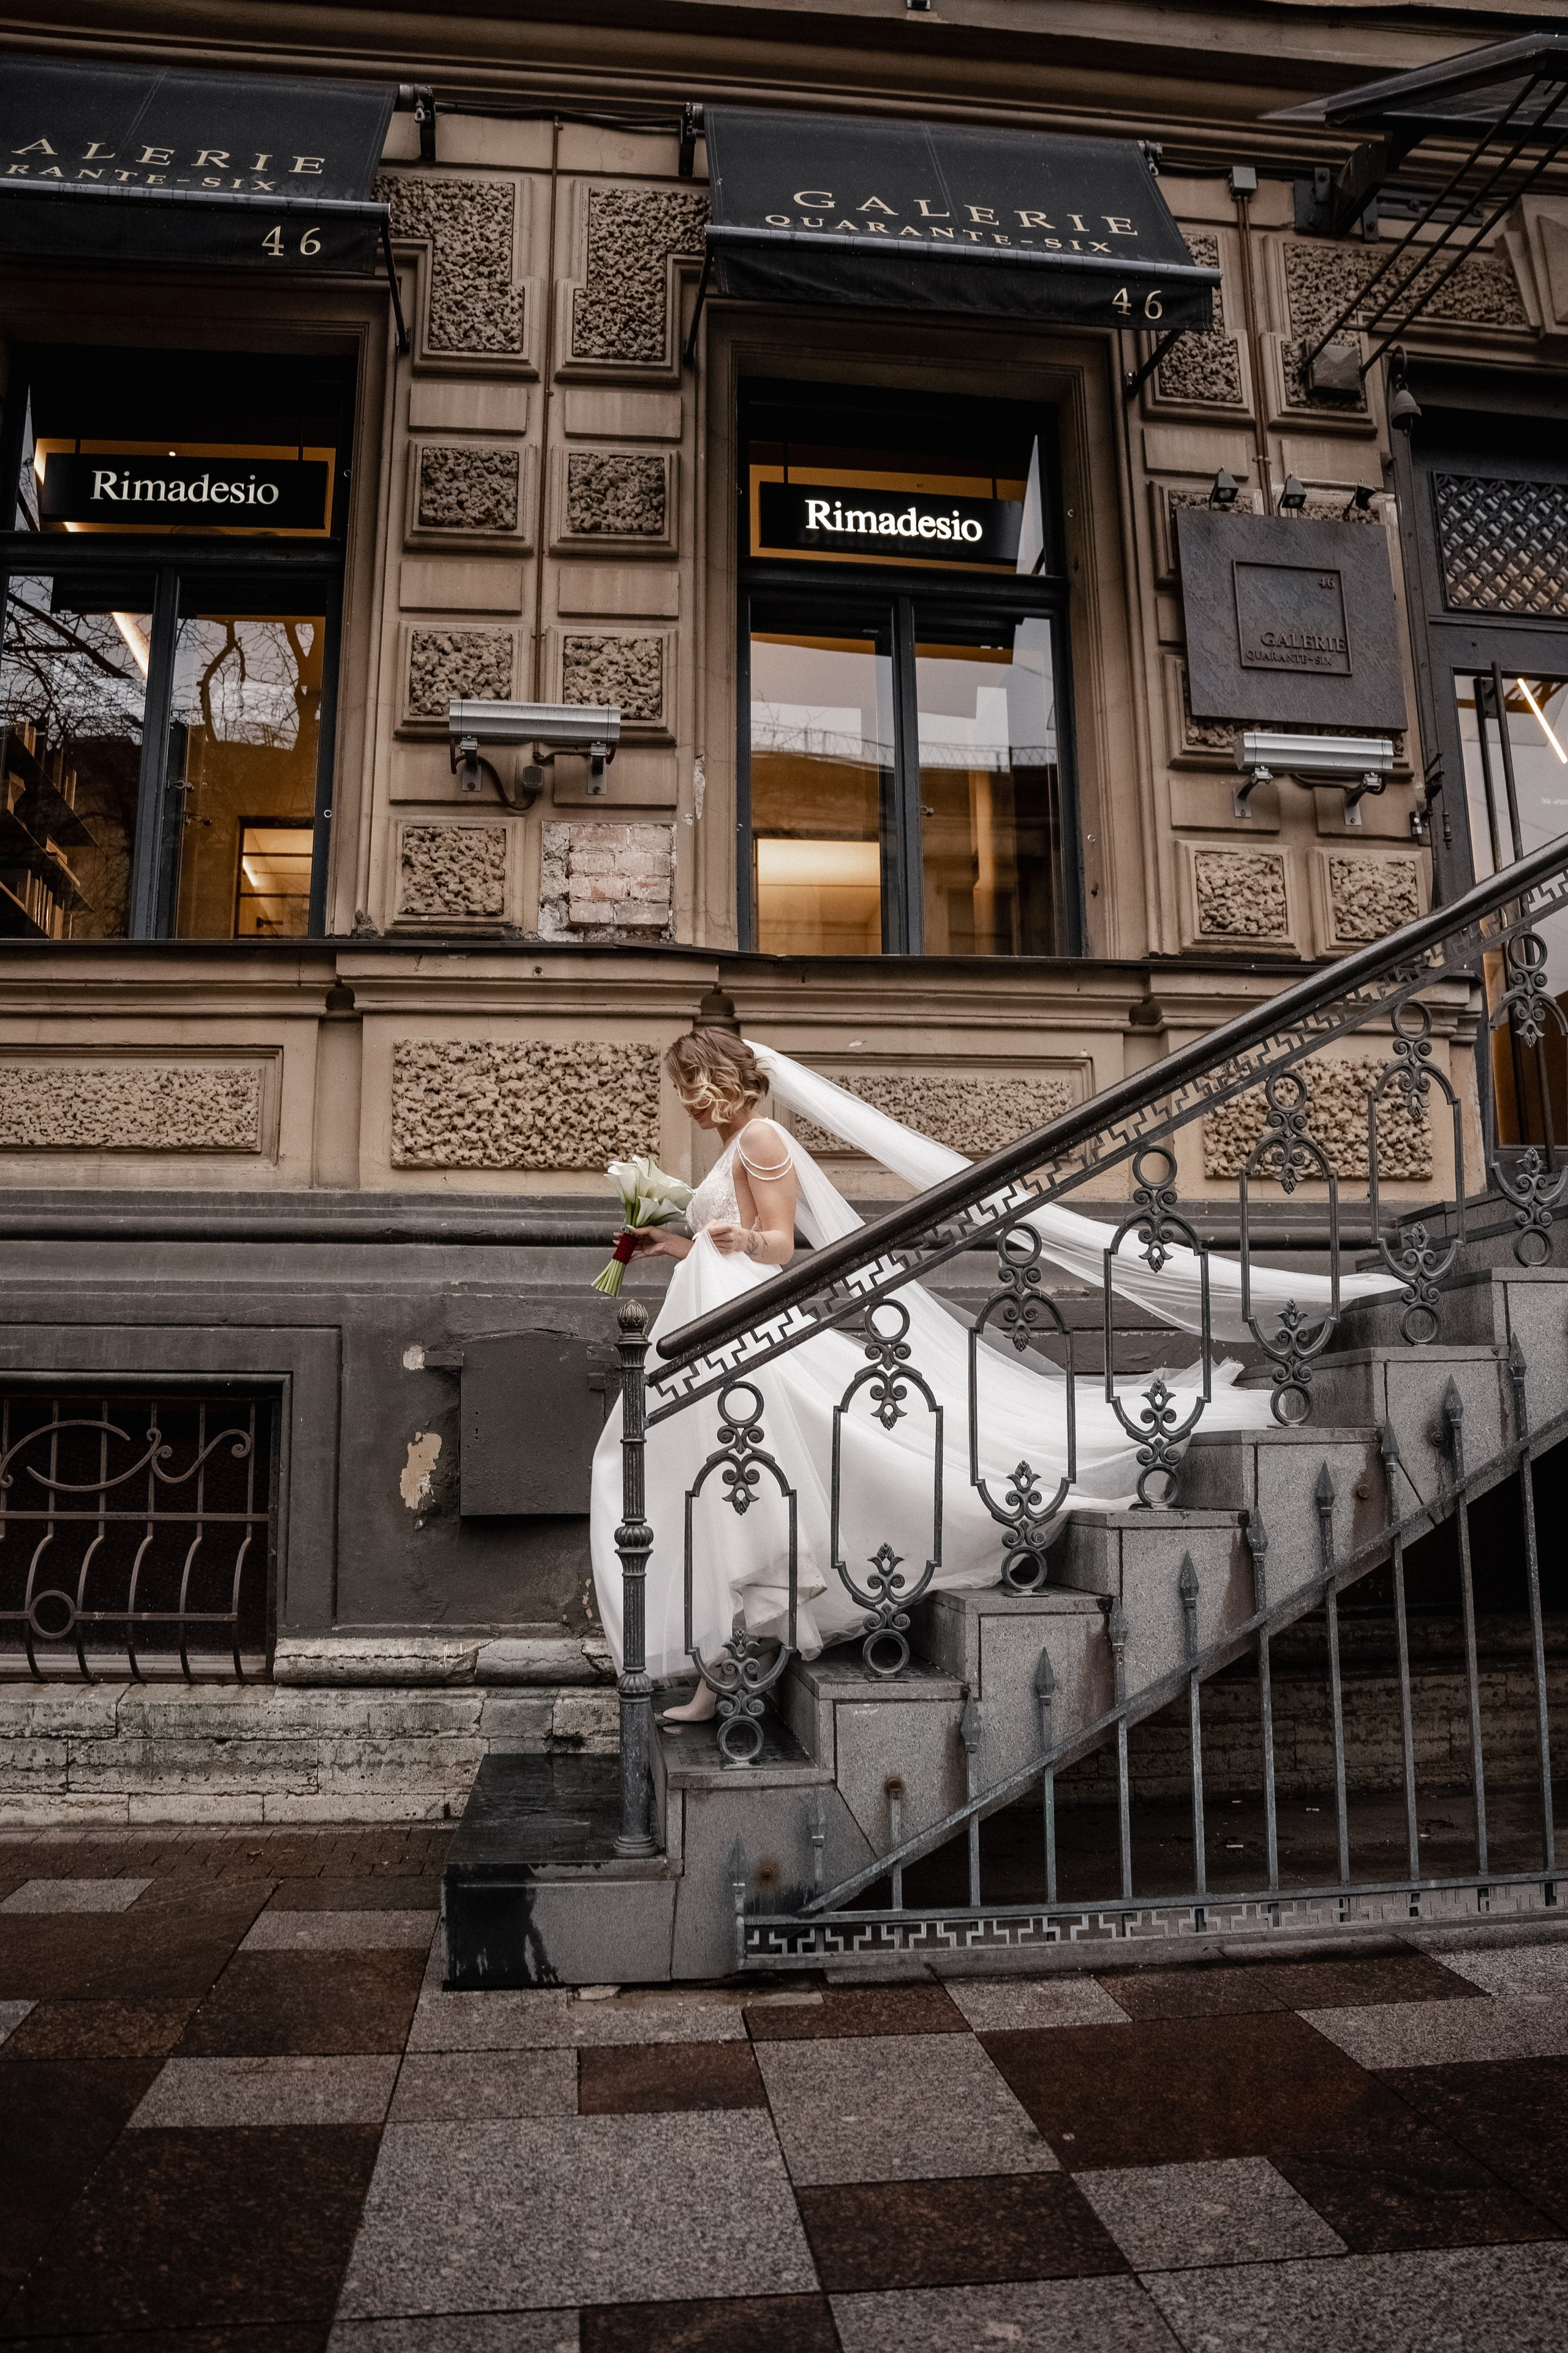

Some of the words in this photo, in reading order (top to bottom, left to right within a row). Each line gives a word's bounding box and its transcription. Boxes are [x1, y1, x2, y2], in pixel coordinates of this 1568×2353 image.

[11, 138, 325, 175] ALERIE
[793, 191, 1138, 236] GALERIE
[261, 225, 322, 256] 46
[764, 214, 1112, 253] QUARANTE-SIX
[1112, 287, 1163, 320] 46
[89, 470, 279, 505] Rimadesio
[804, 499, 983, 542] Rimadesio
[1318, 576, 1335, 589] 46
[1260, 632, 1346, 653] GALERIE
